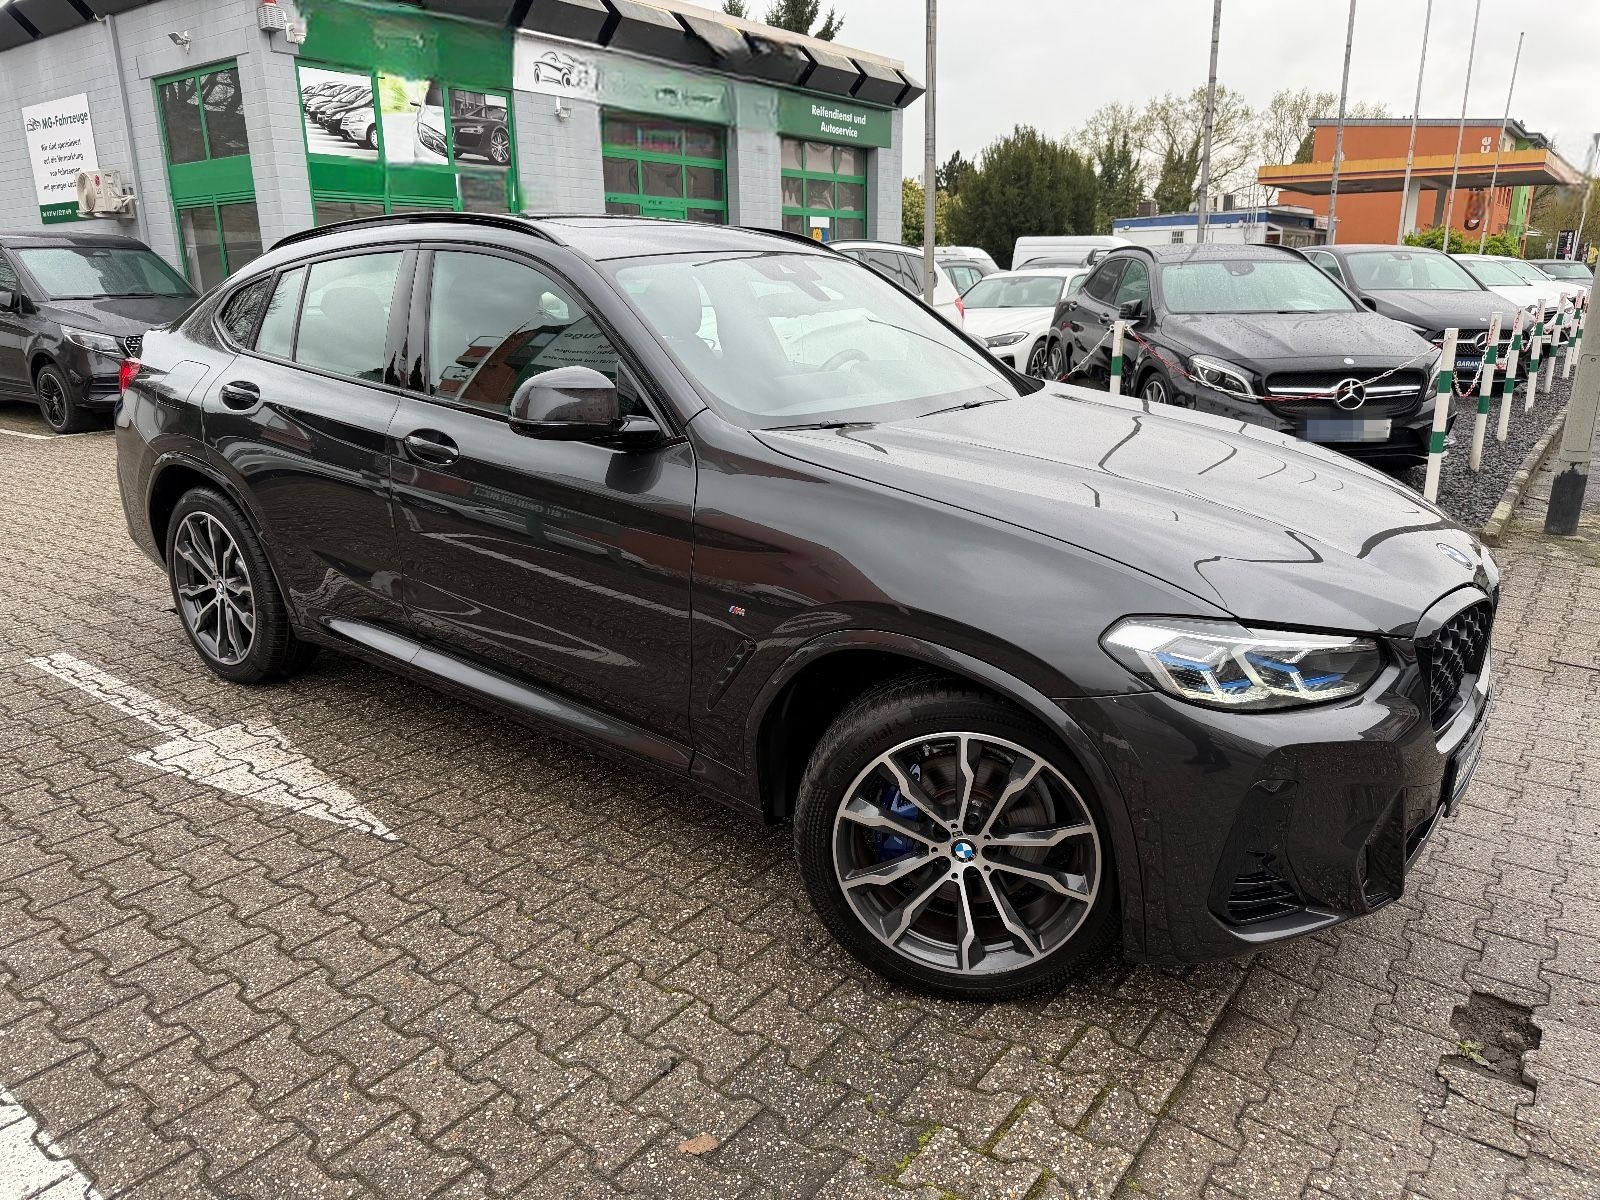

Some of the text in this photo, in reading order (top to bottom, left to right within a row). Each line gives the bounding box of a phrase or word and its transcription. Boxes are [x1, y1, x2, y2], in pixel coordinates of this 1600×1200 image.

[41, 111, 89, 130] MG-Fahrzeuge
[811, 104, 867, 125] Reifendienst und
[820, 121, 858, 138] Autoservice
